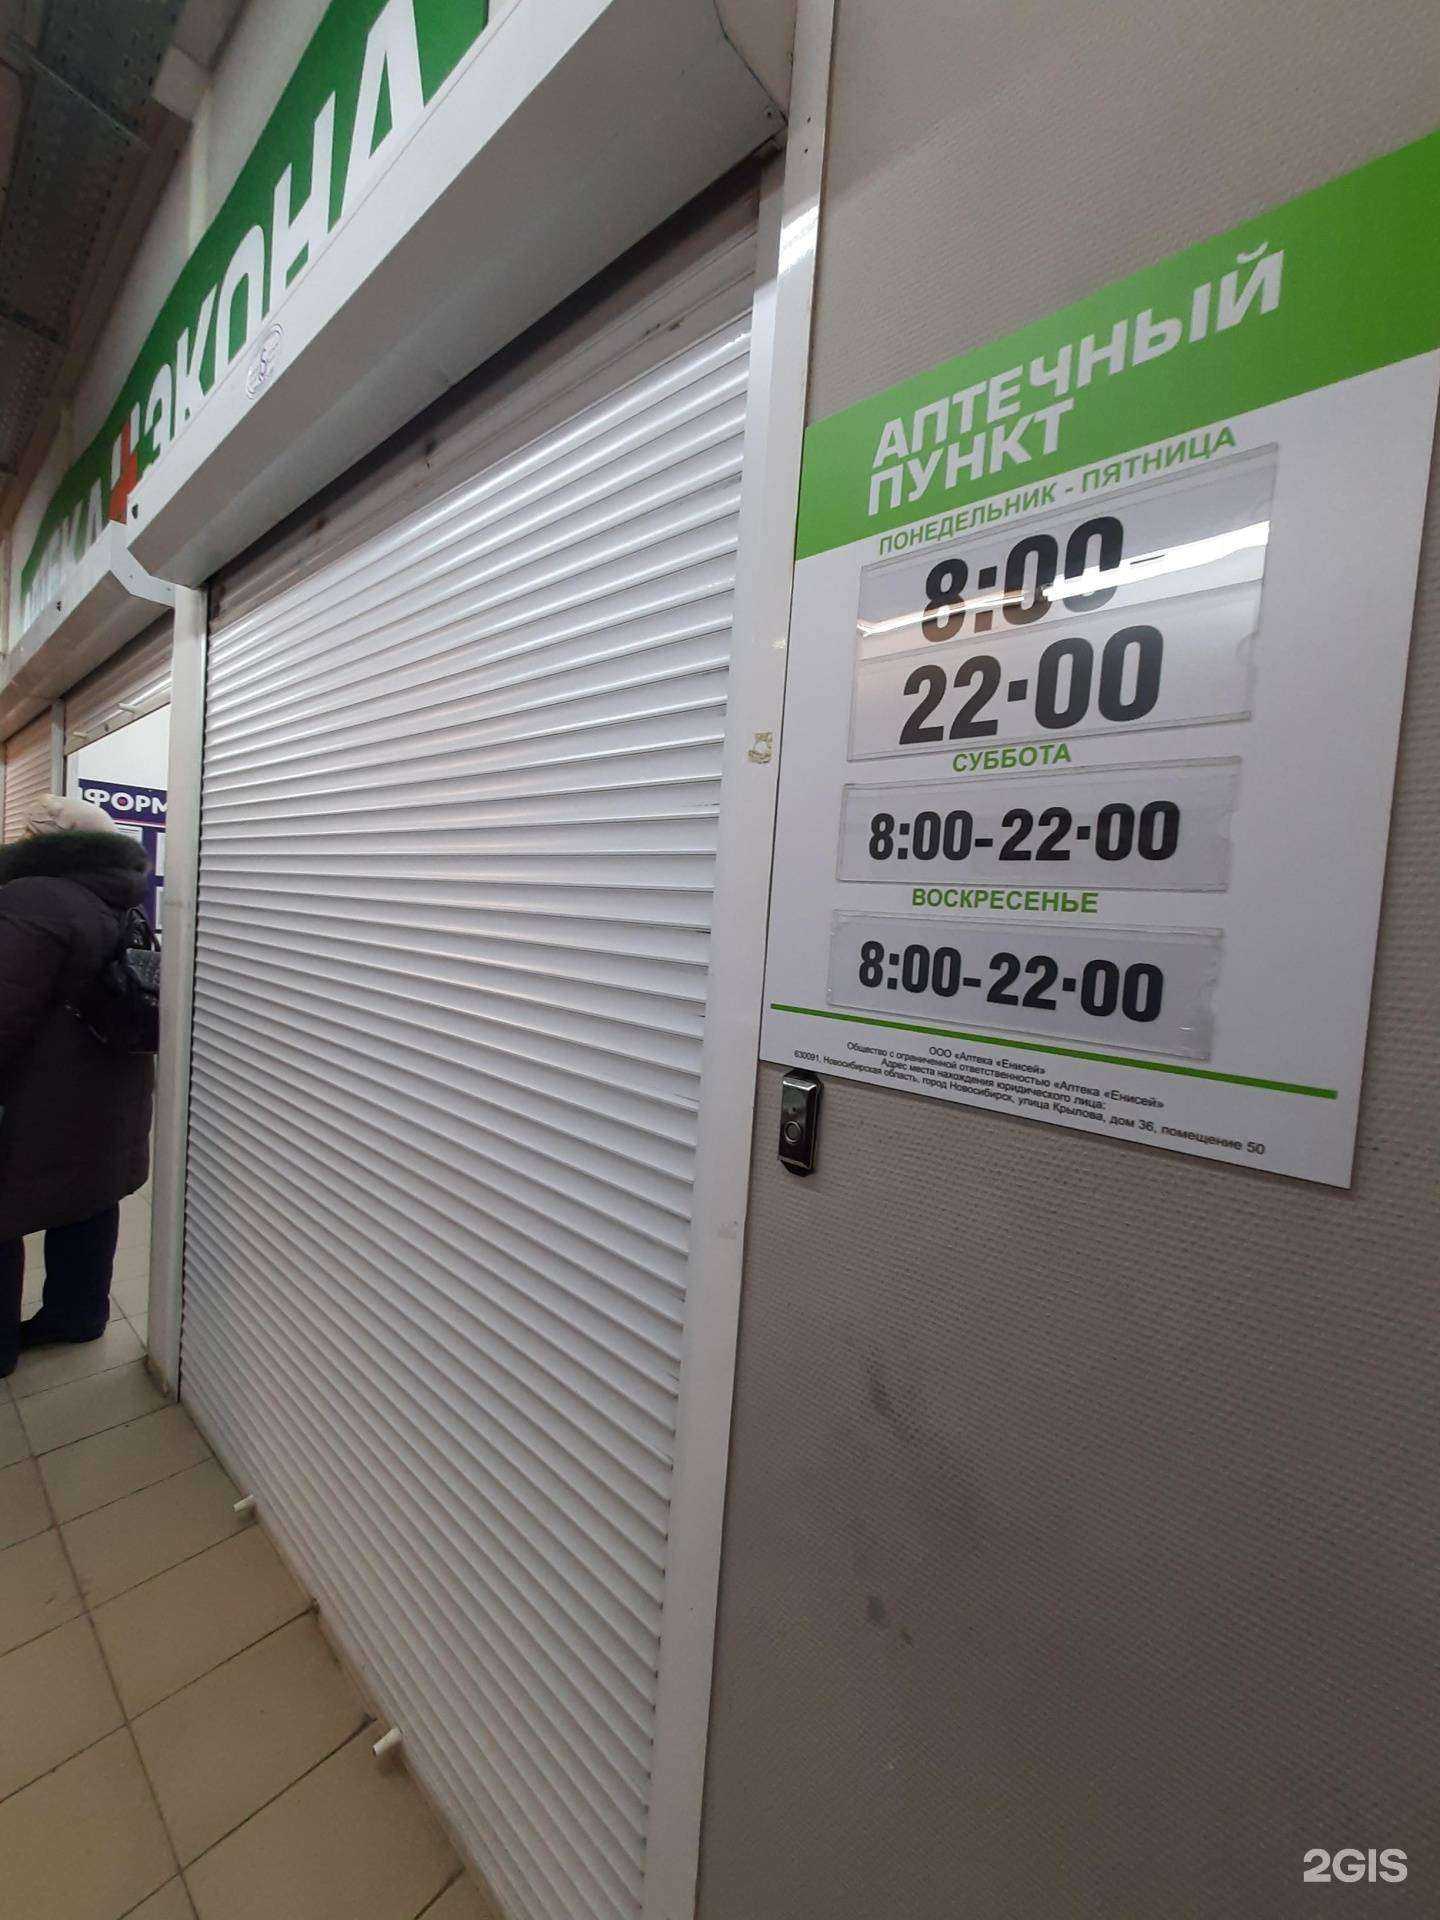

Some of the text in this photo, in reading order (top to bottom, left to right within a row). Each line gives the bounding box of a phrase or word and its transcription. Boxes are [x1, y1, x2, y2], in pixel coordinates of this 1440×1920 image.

[871, 241, 1285, 468] АПТЕЧНЫЙ
[867, 399, 1074, 516] ПУНКТ
[879, 485, 1056, 556] ПОНЕДЕЛЬНИК
[1081, 426, 1238, 491] ПЯТНИЦА
[952, 743, 1072, 773] СУББОТА
[79, 787, 168, 814] ФОРМ
[912, 888, 1099, 914] ВОСКРЕСЕНЬЕ
[846, 1041, 888, 1057] Общество
[896, 1051, 957, 1071] ограниченной
[959, 1063, 1051, 1088] ответственностью
[1053, 1080, 1100, 1097] «Аптека
[1104, 1089, 1164, 1110] «Енисей»
[881, 1057, 1106, 1111] Адрес места нахождения юридического лица:
[928, 1047, 1046, 1075] ООО «Аптека «Енисей»
[823, 1056, 883, 1076] Новосибирская
[884, 1067, 921, 1083] область,
[922, 1076, 948, 1090] город
[949, 1082, 1015, 1104] Новосибирск,
[1017, 1097, 1050, 1111] улица
[1052, 1101, 1106, 1123] Крылова,
[1109, 1115, 1135, 1129] дом
[1138, 1119, 1157, 1134] 36,
[1161, 1125, 1243, 1152] помещение
[1246, 1141, 1266, 1155] 50
